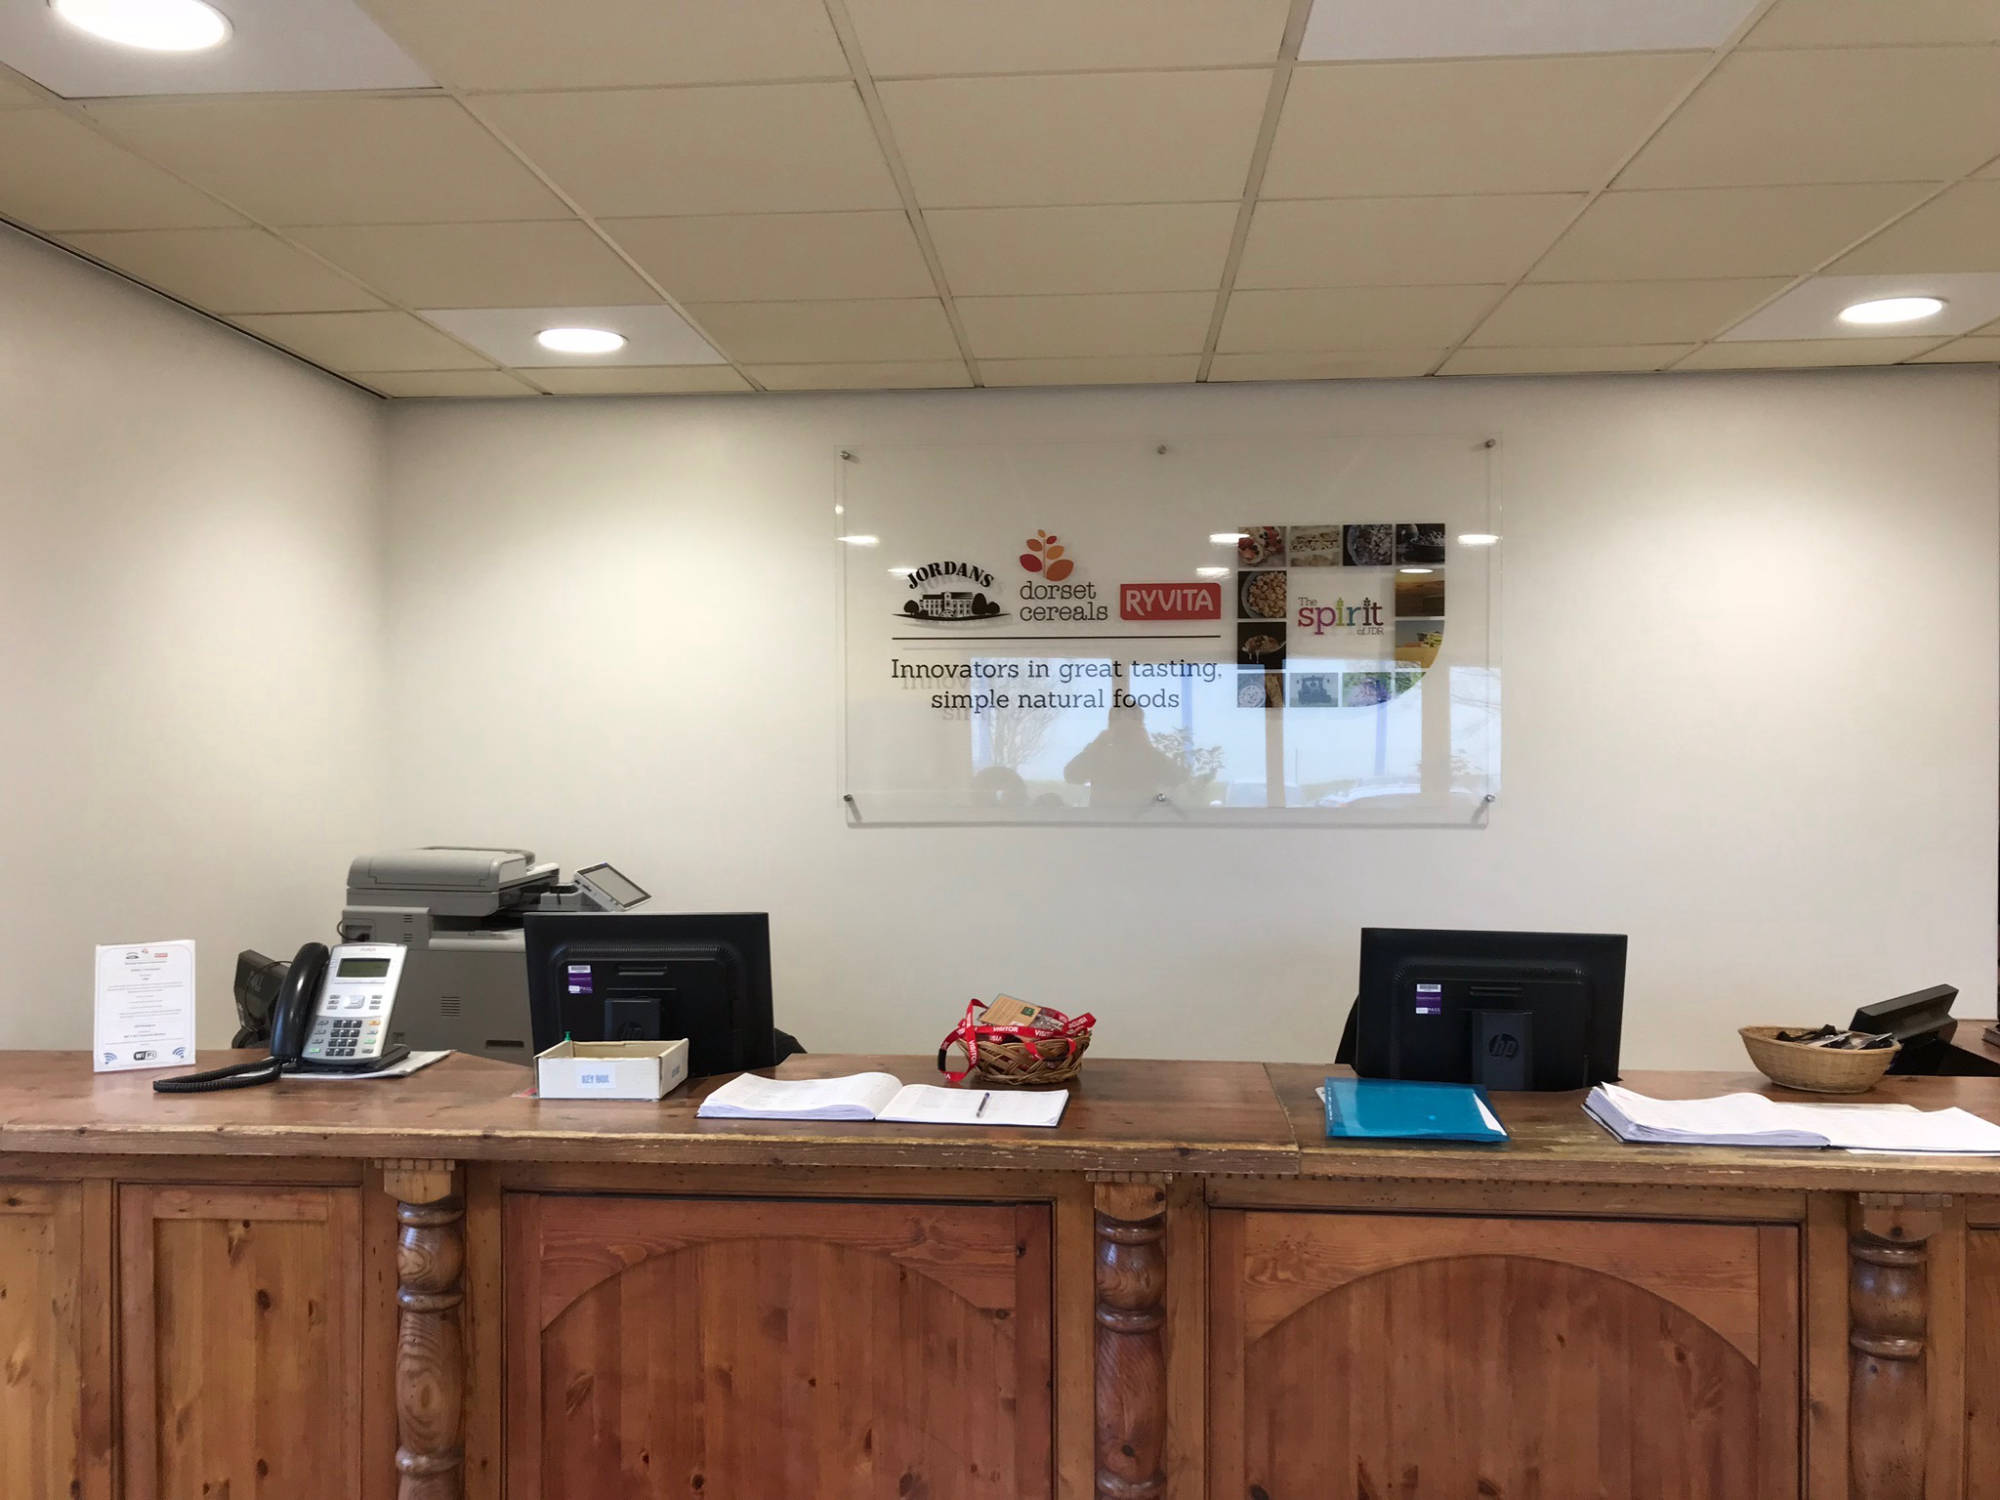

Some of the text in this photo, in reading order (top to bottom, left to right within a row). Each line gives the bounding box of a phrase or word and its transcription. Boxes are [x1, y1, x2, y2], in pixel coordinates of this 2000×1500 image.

[907, 561, 994, 590] JORDANS
[1019, 580, 1097, 600] dorset
[1298, 596, 1318, 606] The
[1019, 602, 1108, 621] cereals
[1125, 589, 1214, 616] RYVITA
[1298, 597, 1384, 635] spirit
[891, 659, 1019, 678] Innovators
[1028, 659, 1050, 677] in
[1059, 660, 1122, 683] great
[931, 689, 1180, 713] simple natural foods
